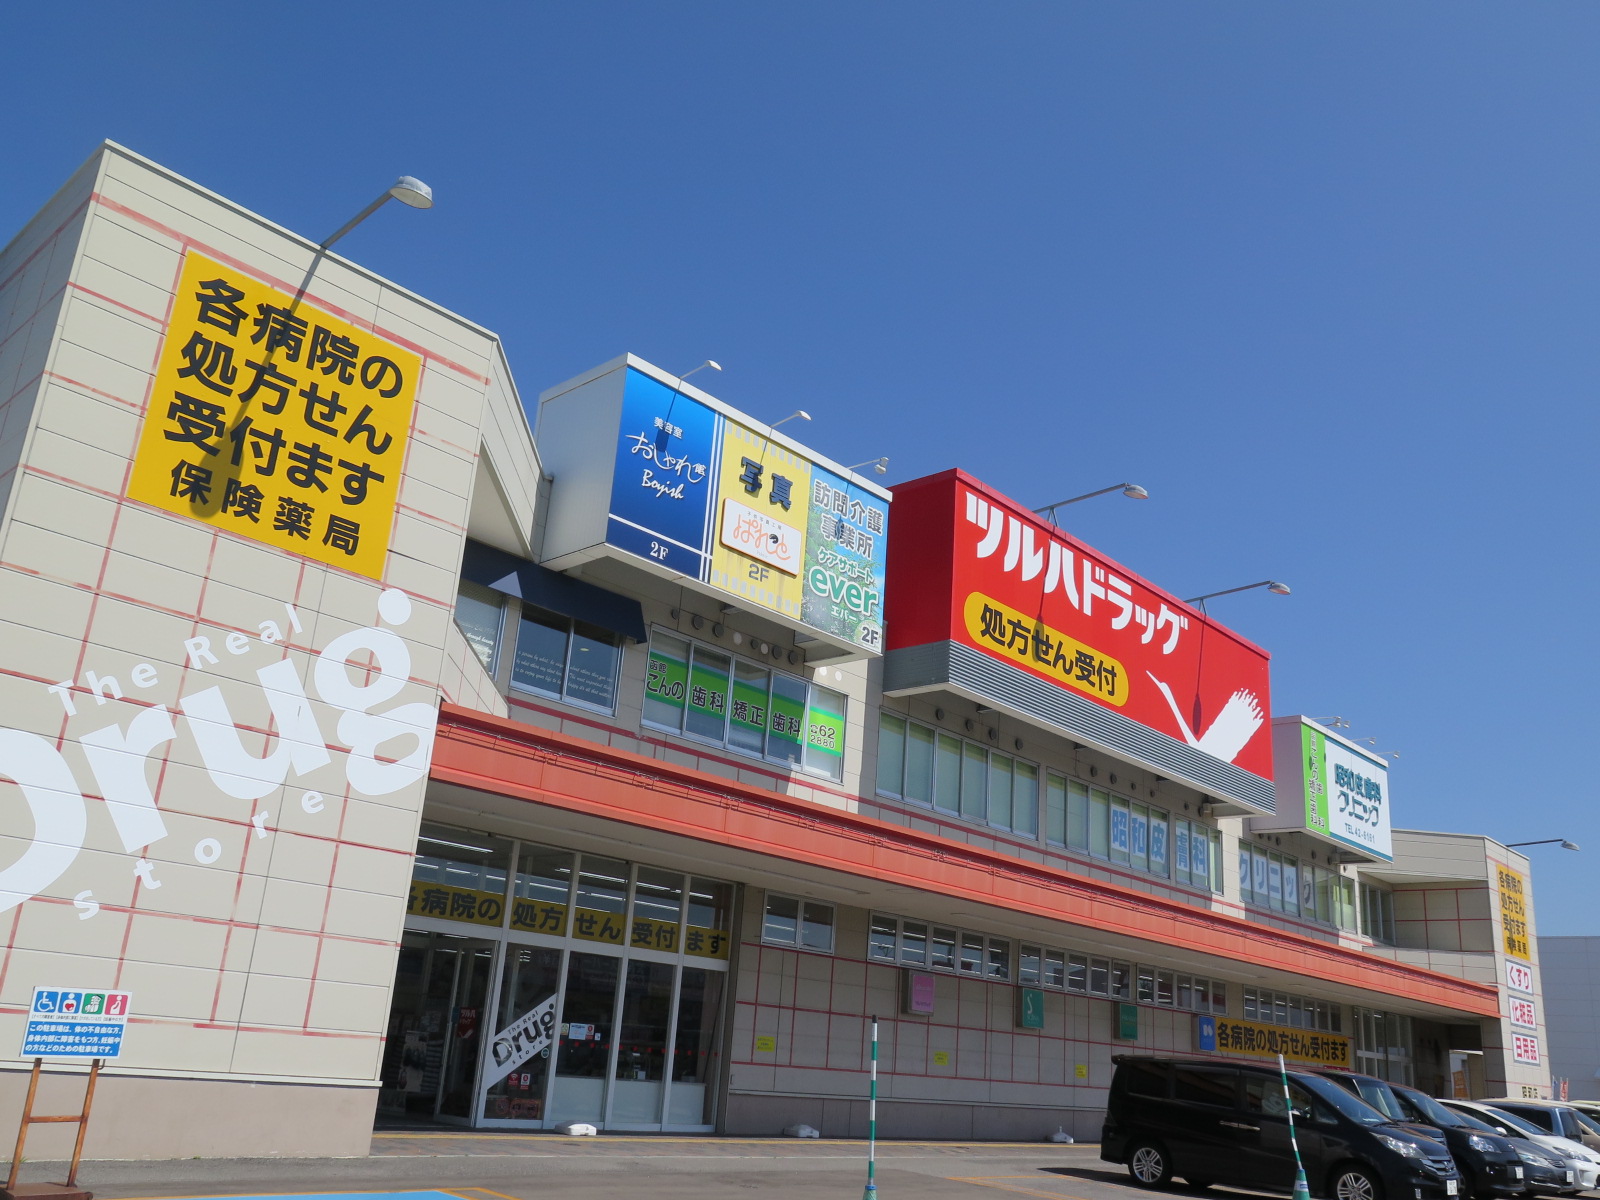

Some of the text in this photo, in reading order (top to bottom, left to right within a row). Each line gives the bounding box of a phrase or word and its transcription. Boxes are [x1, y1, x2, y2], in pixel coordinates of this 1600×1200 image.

[195, 278, 403, 399] 各病院の
[177, 331, 393, 455] 処方せん
[163, 391, 385, 505] 受付ます
[653, 416, 683, 439] 美容室
[625, 432, 707, 483] おしゃれ館
[641, 469, 684, 500] Boyish
[739, 456, 793, 511] 写真
[170, 459, 361, 556] 保険薬局
[813, 478, 883, 536] 訪問介護
[649, 541, 669, 560] 2F
[820, 515, 874, 559] 事業所
[748, 563, 769, 582] 2F
[817, 546, 874, 584] ケアサポート
[965, 491, 1189, 655] ツルハドラッグ
[808, 565, 879, 616] ever
[830, 605, 858, 623] エバー
[860, 626, 879, 645] 2F
[980, 603, 1117, 697] 処方せん受付
[48, 603, 303, 717] The Real
[649, 659, 667, 674] 函館
[810, 734, 835, 749] 2880
[1334, 763, 1382, 806] 昭和皮膚科
[1337, 790, 1380, 827] クリニック
[1344, 822, 1354, 835] TEL
[73, 790, 325, 920] store
[1509, 966, 1530, 990] くすり
[522, 1010, 539, 1025] Real
[1511, 999, 1534, 1026] 化粧品
[492, 1003, 555, 1067] Drug
[1217, 1021, 1348, 1062] 各病院の処方せん受付ます
[1515, 1036, 1538, 1061] 日用品
